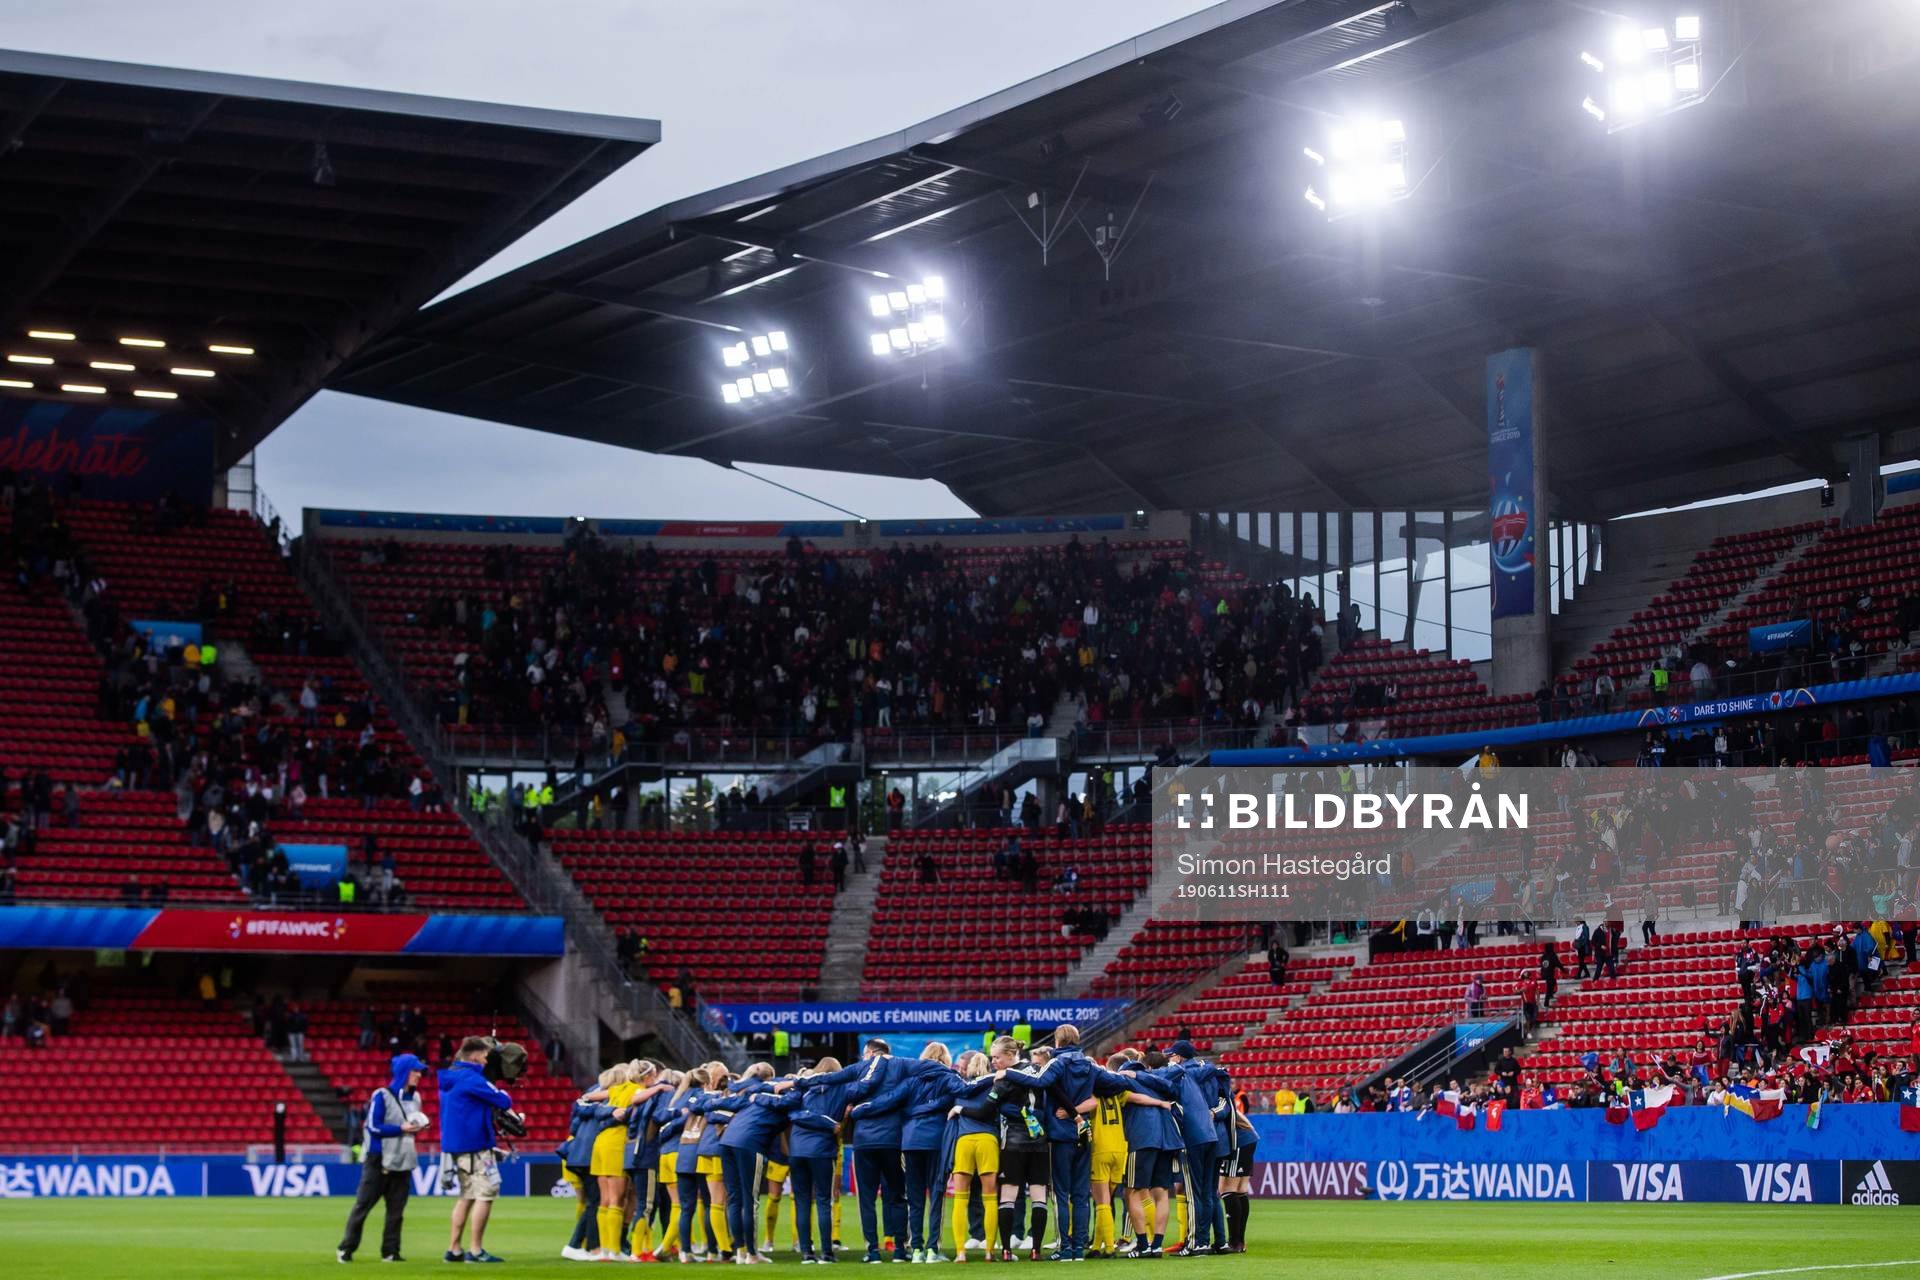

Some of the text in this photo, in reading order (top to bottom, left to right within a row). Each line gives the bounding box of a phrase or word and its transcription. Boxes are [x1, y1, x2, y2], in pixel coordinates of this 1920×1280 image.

[1694, 699, 1753, 716] DARE TO SHINE
[750, 1011, 799, 1024] COUPE
[803, 1011, 824, 1024] DU
[827, 1010, 881, 1024] MONDE
[884, 1008, 951, 1024] FÉMININE
[954, 1010, 972, 1022] DE
[975, 1009, 993, 1022] LA
[995, 1009, 1020, 1022] FIFA
[1026, 1008, 1073, 1021] FRANCE
[35, 1164, 175, 1197] WANDA
[241, 1164, 330, 1197] VISA
[1259, 1161, 1368, 1196] AIRWAYS
[1413, 1161, 1470, 1200] 万达
[1471, 1163, 1576, 1198] WANDA
[1612, 1163, 1684, 1201] VISA
[1735, 1163, 1812, 1202] VISA
[1852, 1189, 1900, 1206] adidas
